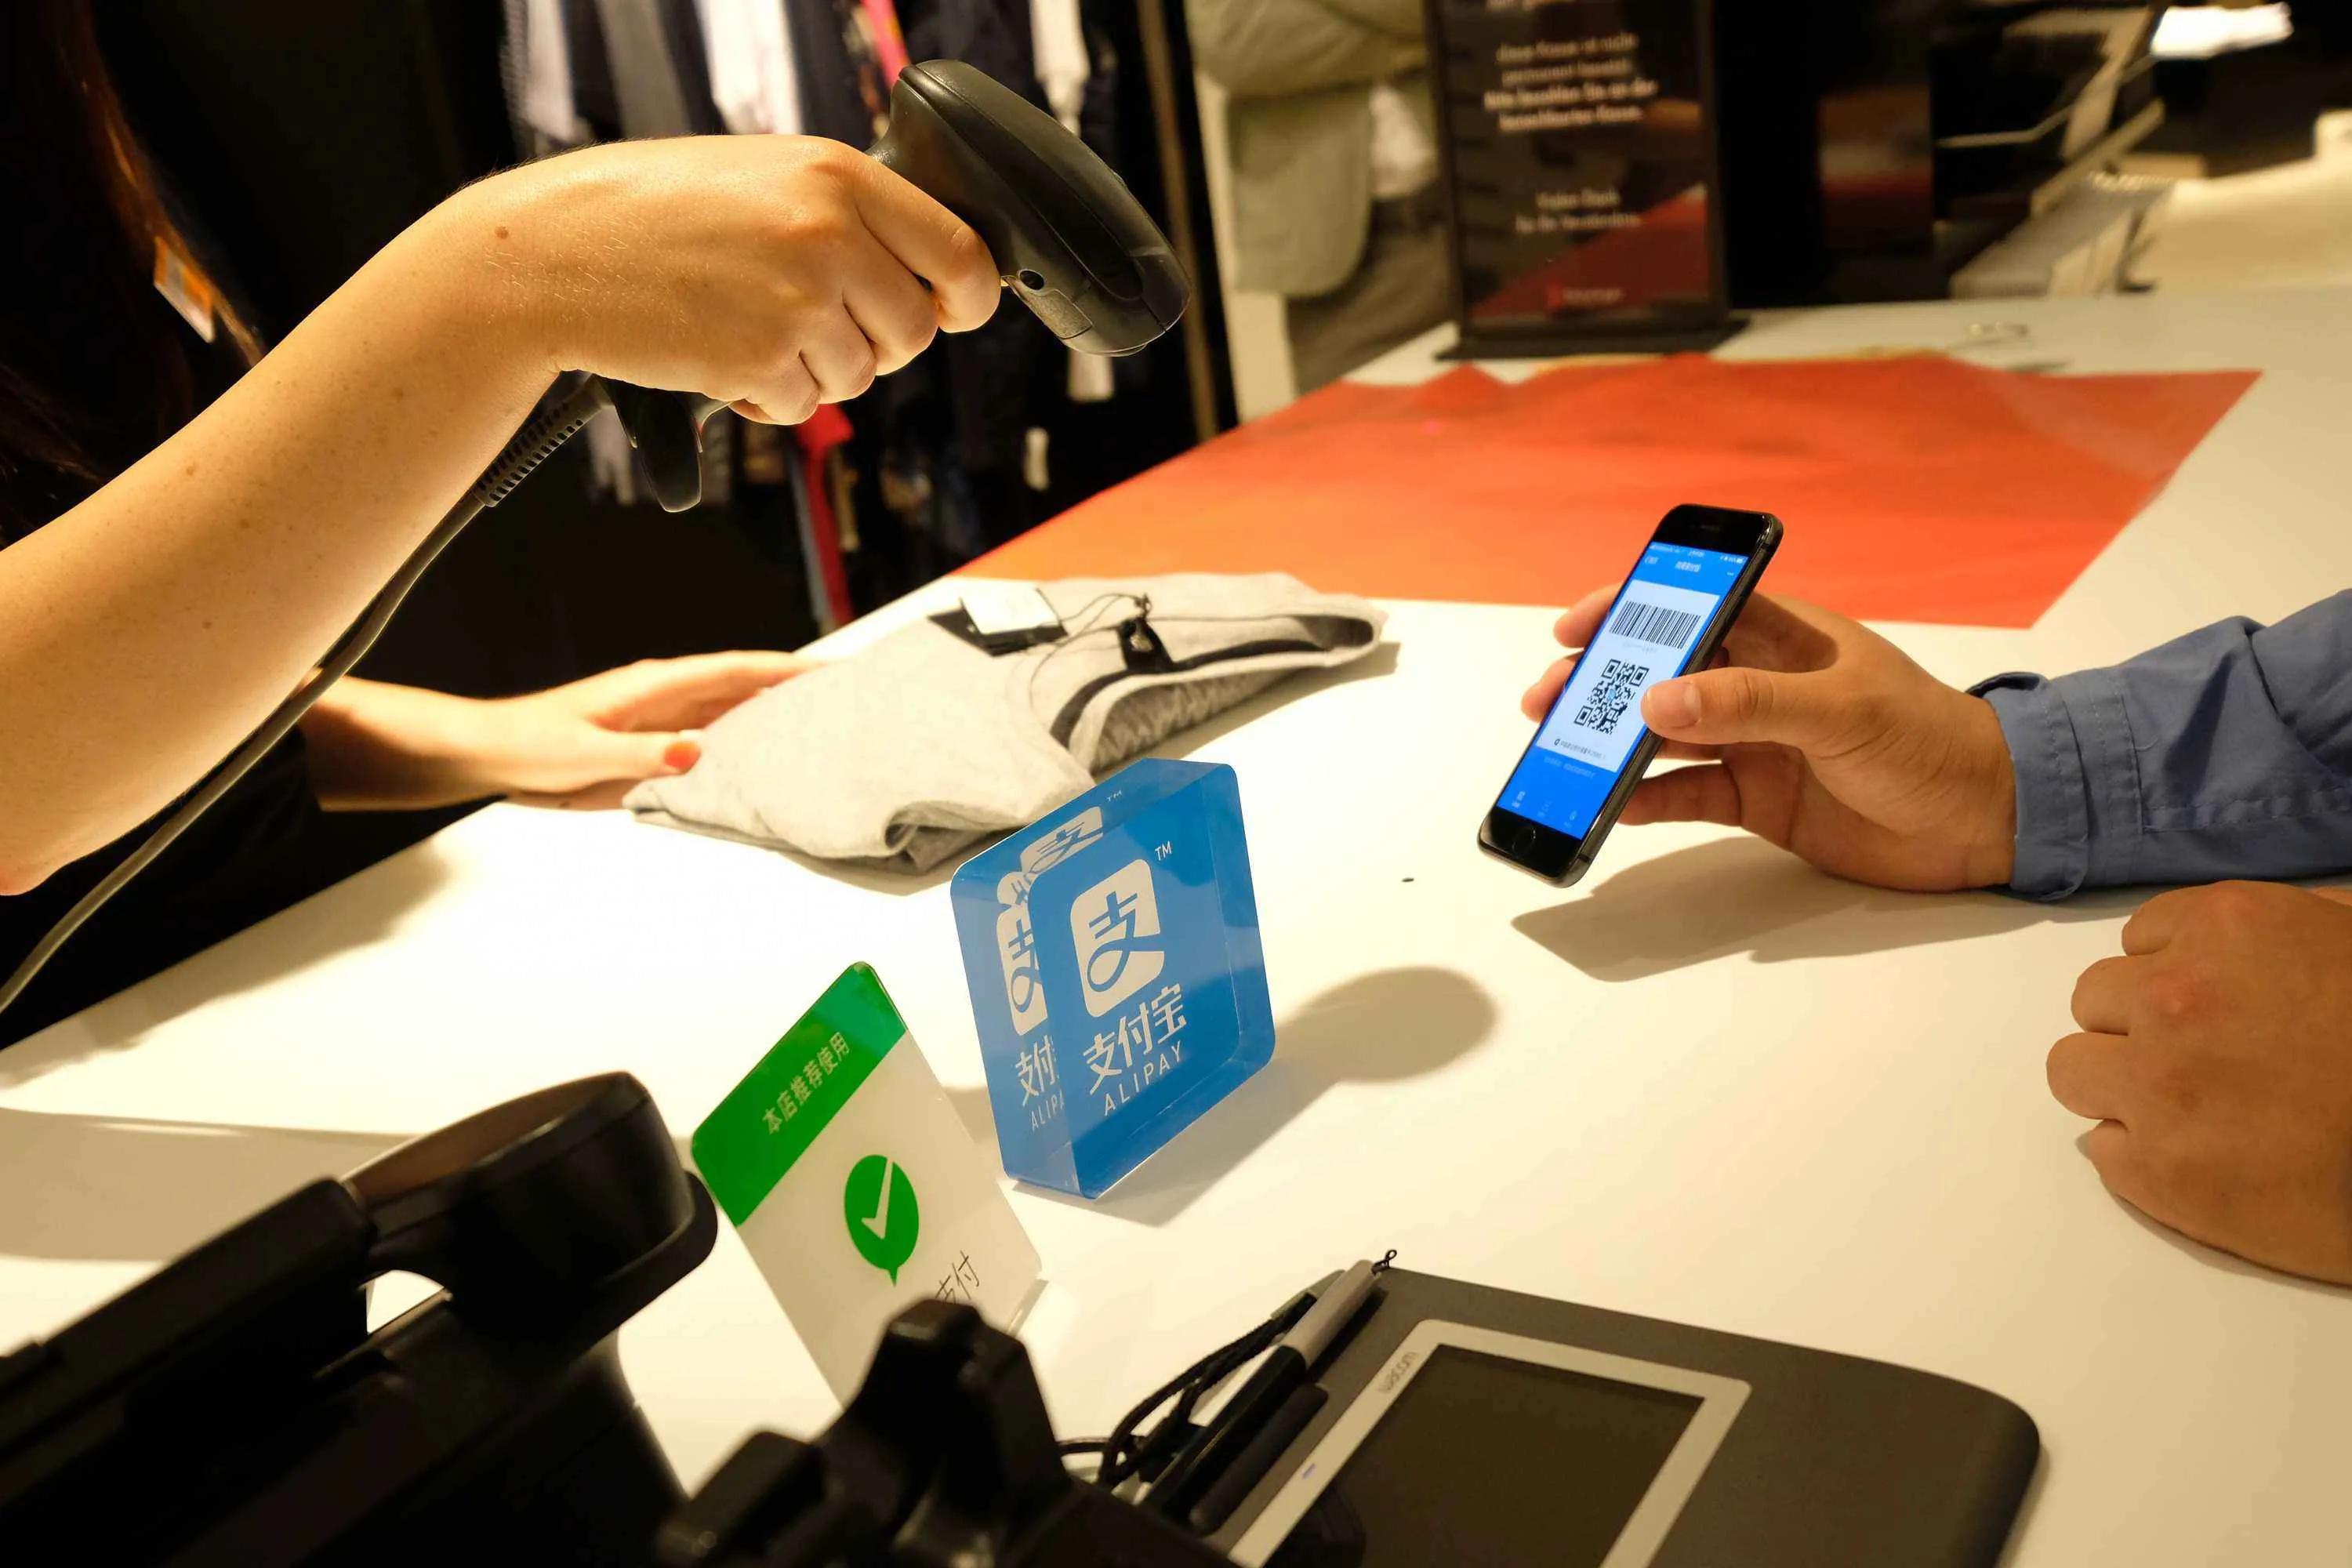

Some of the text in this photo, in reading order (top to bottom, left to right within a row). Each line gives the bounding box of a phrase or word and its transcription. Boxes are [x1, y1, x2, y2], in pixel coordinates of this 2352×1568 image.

[1154, 840, 1172, 861] TM
[1015, 1034, 1059, 1107] 支付
[1082, 982, 1187, 1095] 支付宝
[762, 1032, 850, 1134] 本店推荐使用
[1104, 1040, 1181, 1116] ALIPAY
